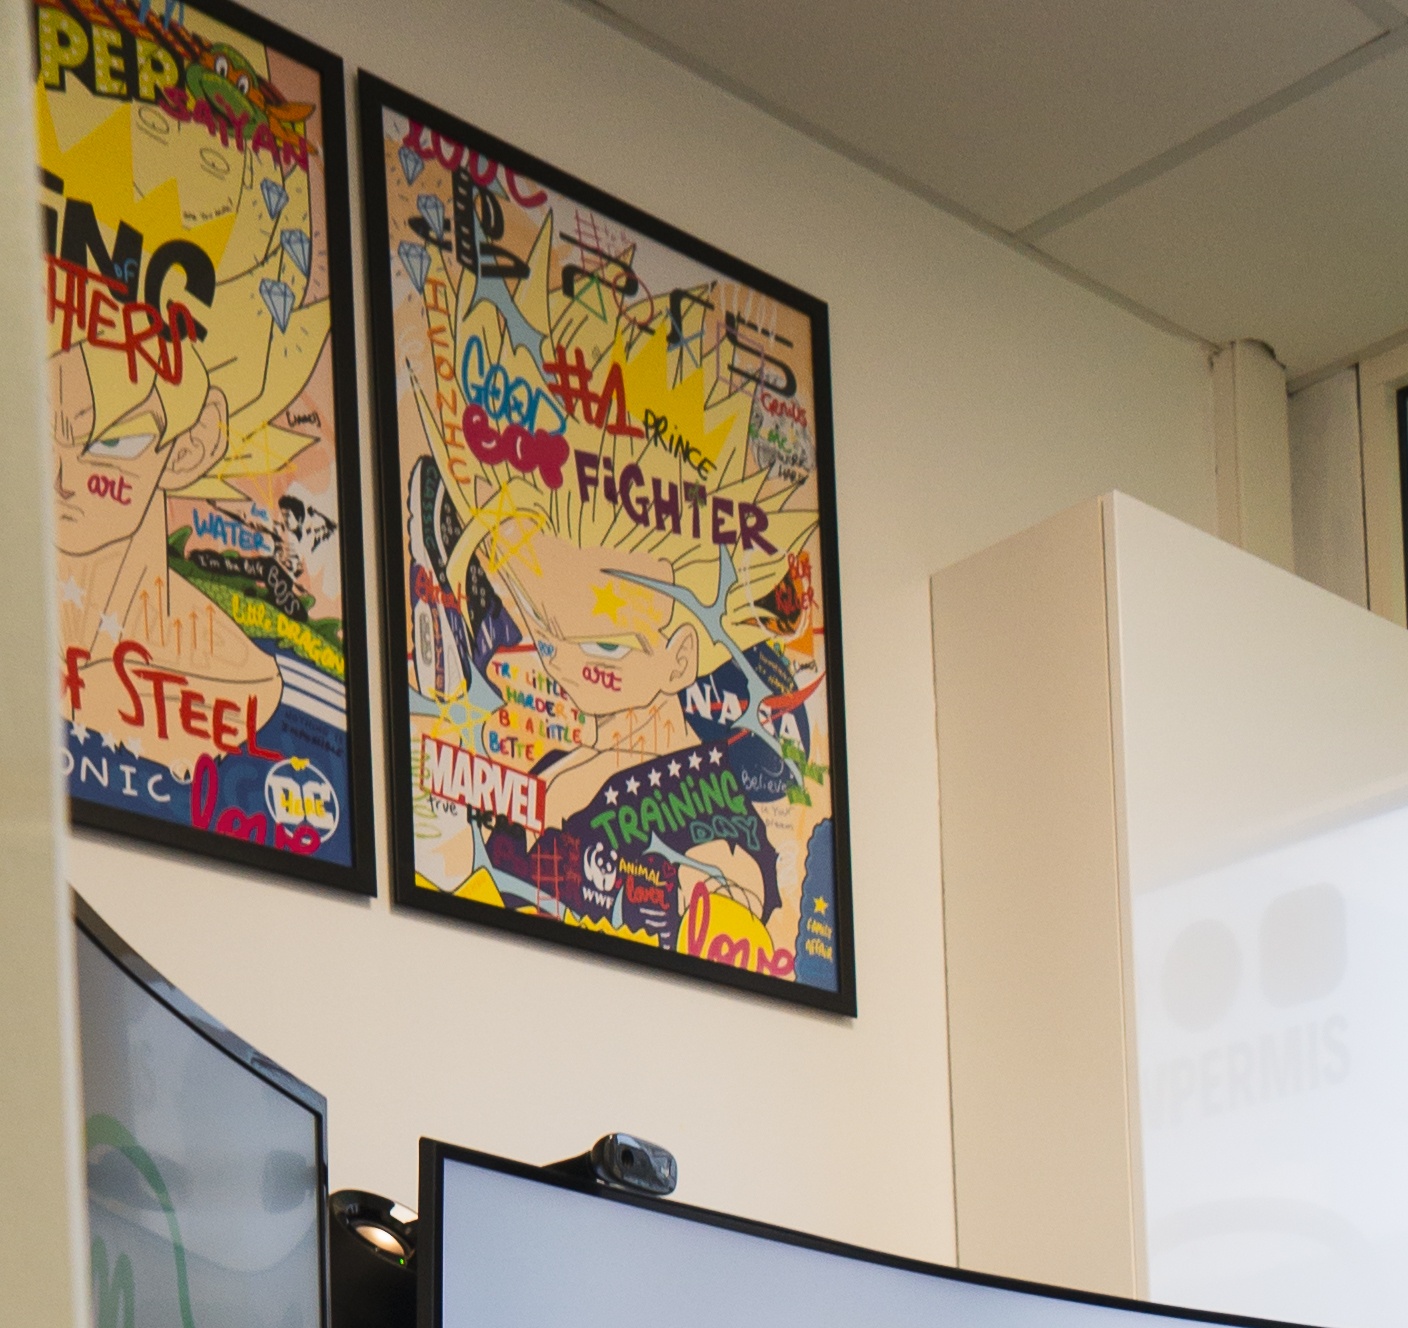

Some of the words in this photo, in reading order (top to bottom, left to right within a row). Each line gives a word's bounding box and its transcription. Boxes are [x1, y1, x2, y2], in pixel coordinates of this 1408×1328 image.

[543, 344, 645, 439] #1
[192, 508, 271, 552] WATER
[424, 736, 541, 831] MARVEL
[583, 886, 612, 909] WWF
